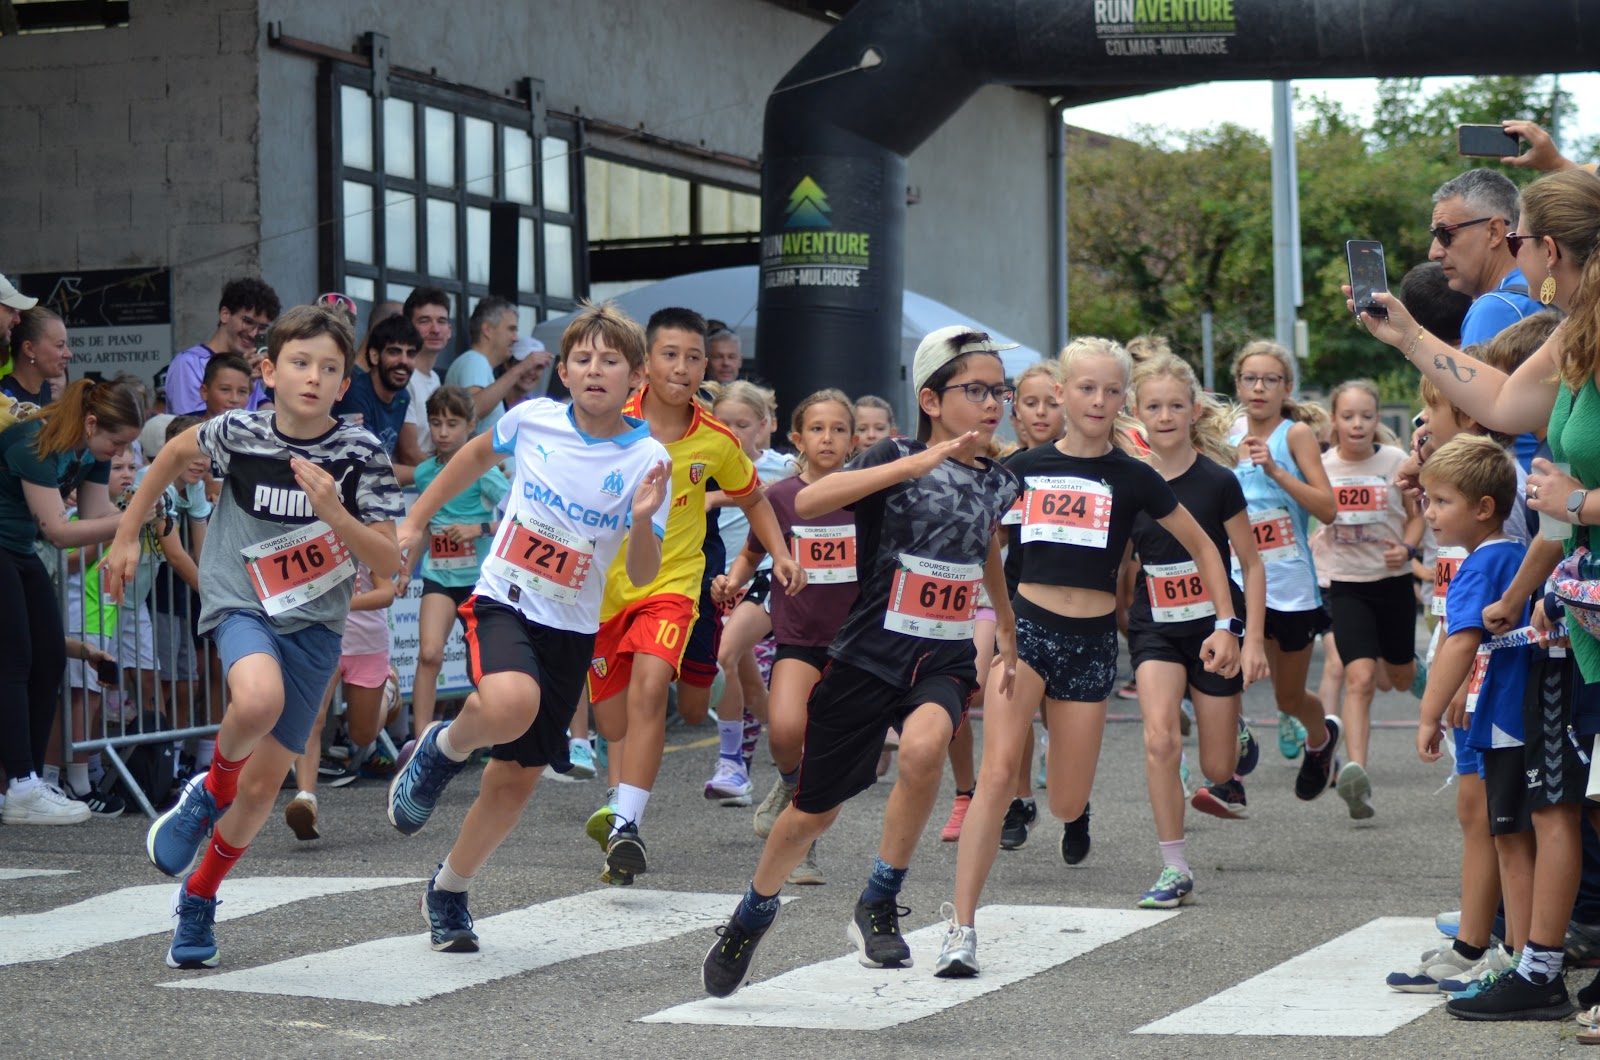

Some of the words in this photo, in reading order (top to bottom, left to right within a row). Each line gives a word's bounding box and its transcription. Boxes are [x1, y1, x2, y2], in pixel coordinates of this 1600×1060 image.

[1105, 38, 1228, 56] COLMAR-MULHOUSE
[89, 335, 104, 347] DE
[108, 333, 143, 347] PIANO
[94, 350, 161, 363] ARTISTIQUE
[253, 484, 319, 518] PUM
[1041, 493, 1087, 518] 624
[1338, 488, 1370, 505] 620
[529, 517, 555, 533] COURSES
[1252, 524, 1276, 544] 12
[260, 536, 288, 550] COURSES
[274, 536, 308, 551] MAGSTATT
[434, 537, 459, 553] 615
[537, 528, 570, 545] MAGSTATT
[523, 536, 569, 574] 721
[810, 540, 846, 561] 621
[273, 544, 325, 581] 716
[919, 560, 950, 572] COURSES
[931, 570, 966, 580] MAGSTATT
[1435, 562, 1451, 587] 84
[920, 581, 968, 611] 616
[1164, 576, 1203, 600] 618
[655, 619, 680, 649] 10
